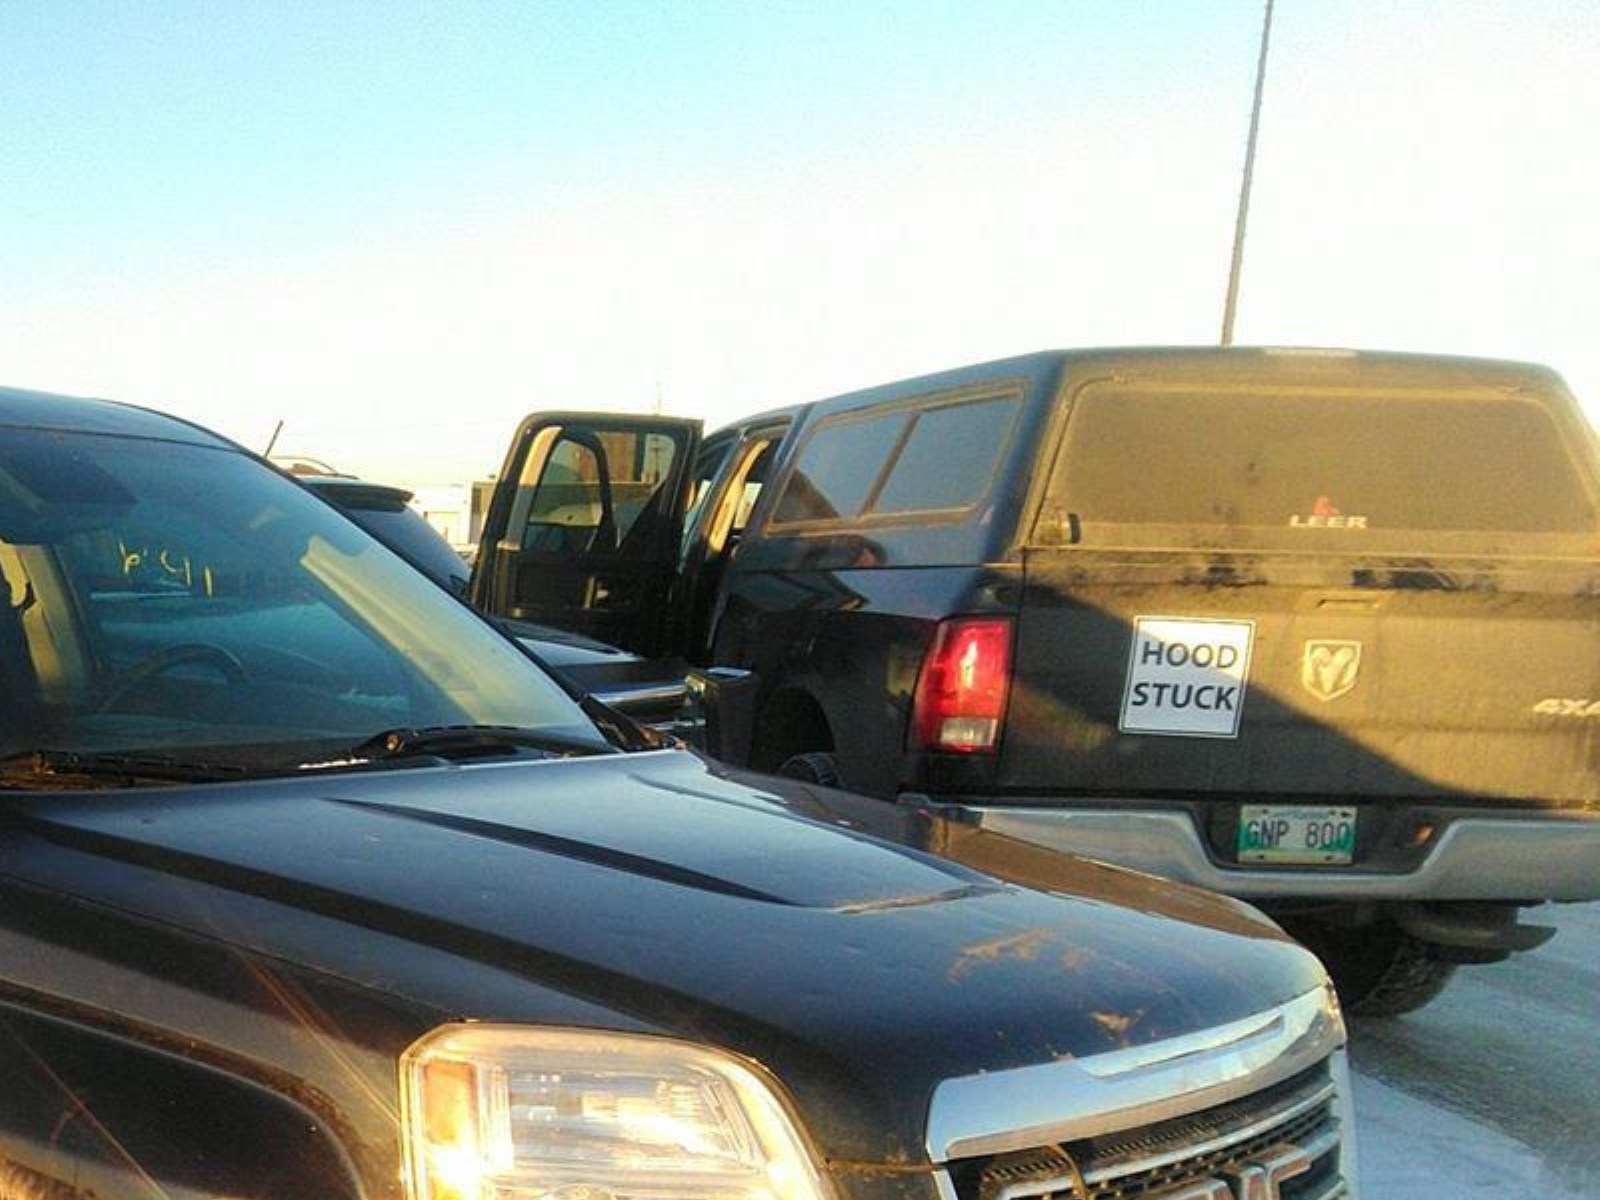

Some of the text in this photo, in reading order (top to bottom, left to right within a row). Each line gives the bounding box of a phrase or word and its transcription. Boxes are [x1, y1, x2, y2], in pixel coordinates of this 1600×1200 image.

[1289, 514, 1367, 529] LEER
[1141, 640, 1238, 668] HOOD
[1131, 682, 1237, 710] STUCK
